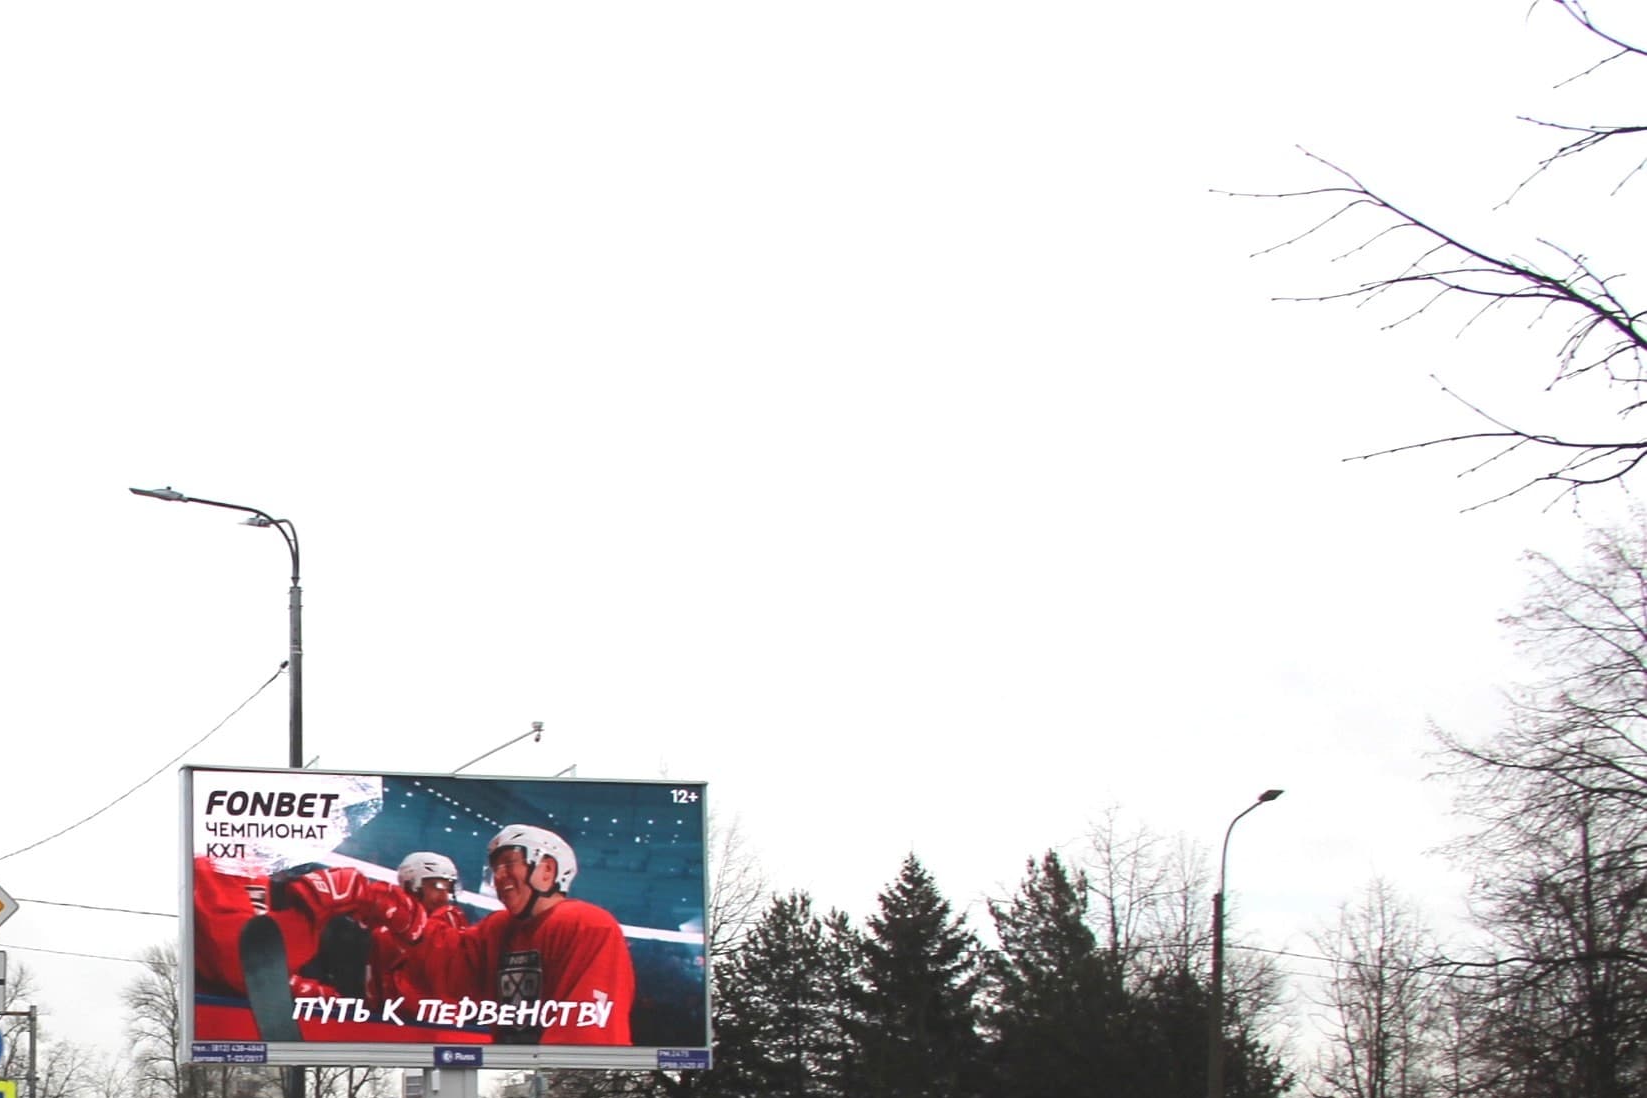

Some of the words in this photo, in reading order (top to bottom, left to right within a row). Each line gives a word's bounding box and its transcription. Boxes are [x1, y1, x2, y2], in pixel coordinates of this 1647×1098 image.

[205, 790, 339, 818] FONBET
[670, 789, 699, 804] 12+
[205, 822, 328, 840] ЧЕМПИОНАТ
[206, 843, 246, 858] КХЛ
[292, 997, 370, 1024] ПУТЬ
[381, 997, 405, 1025] К
[416, 996, 613, 1028] ПЕРВЕНСТВУ
